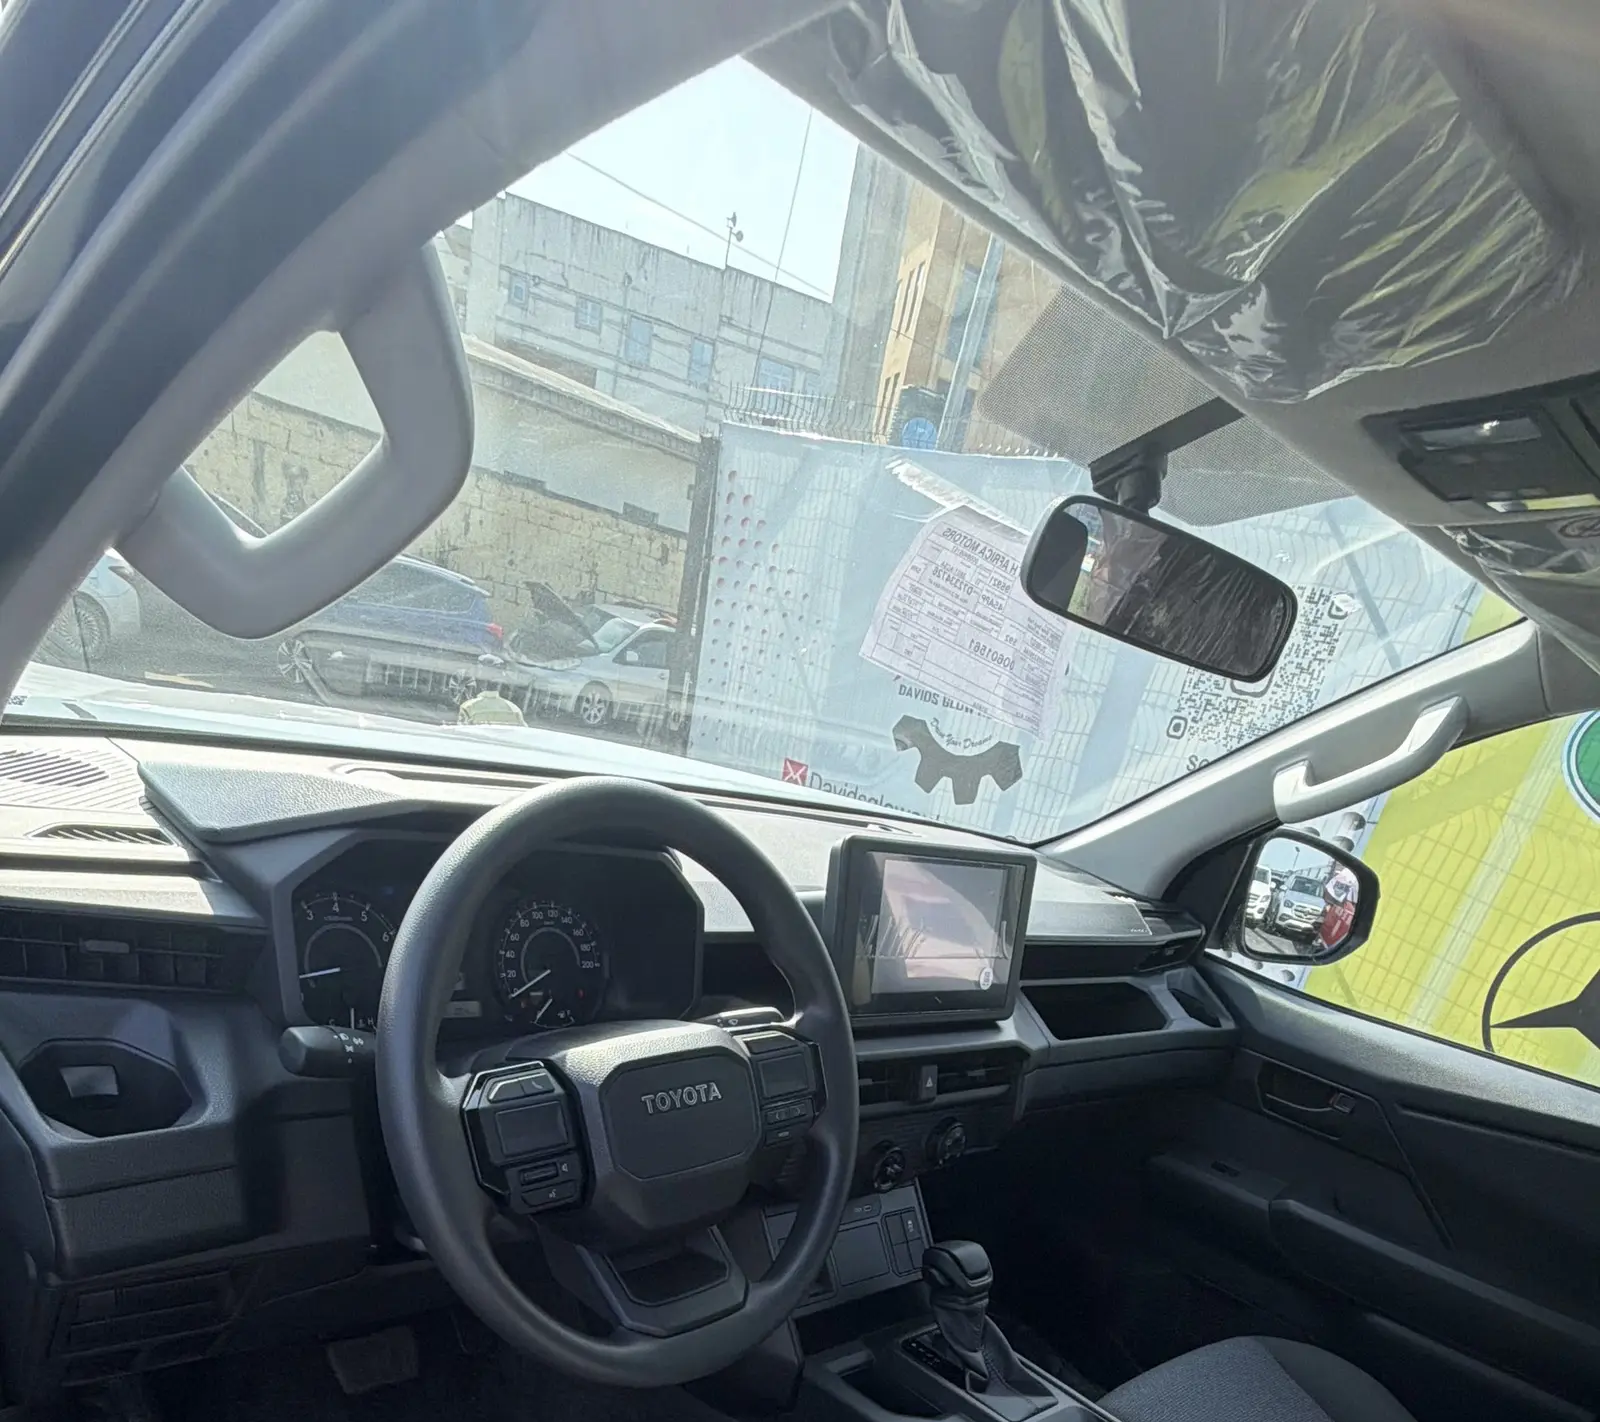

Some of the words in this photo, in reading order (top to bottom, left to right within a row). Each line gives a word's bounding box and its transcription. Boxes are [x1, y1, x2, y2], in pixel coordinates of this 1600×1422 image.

[898, 683, 940, 706] DAVIDS
[519, 919, 530, 928] 80
[561, 916, 573, 924] 140
[573, 928, 584, 937] 160
[510, 933, 520, 942] 60
[582, 960, 594, 969] 200
[507, 969, 517, 978] 20
[641, 1082, 722, 1114] TOYOTA
